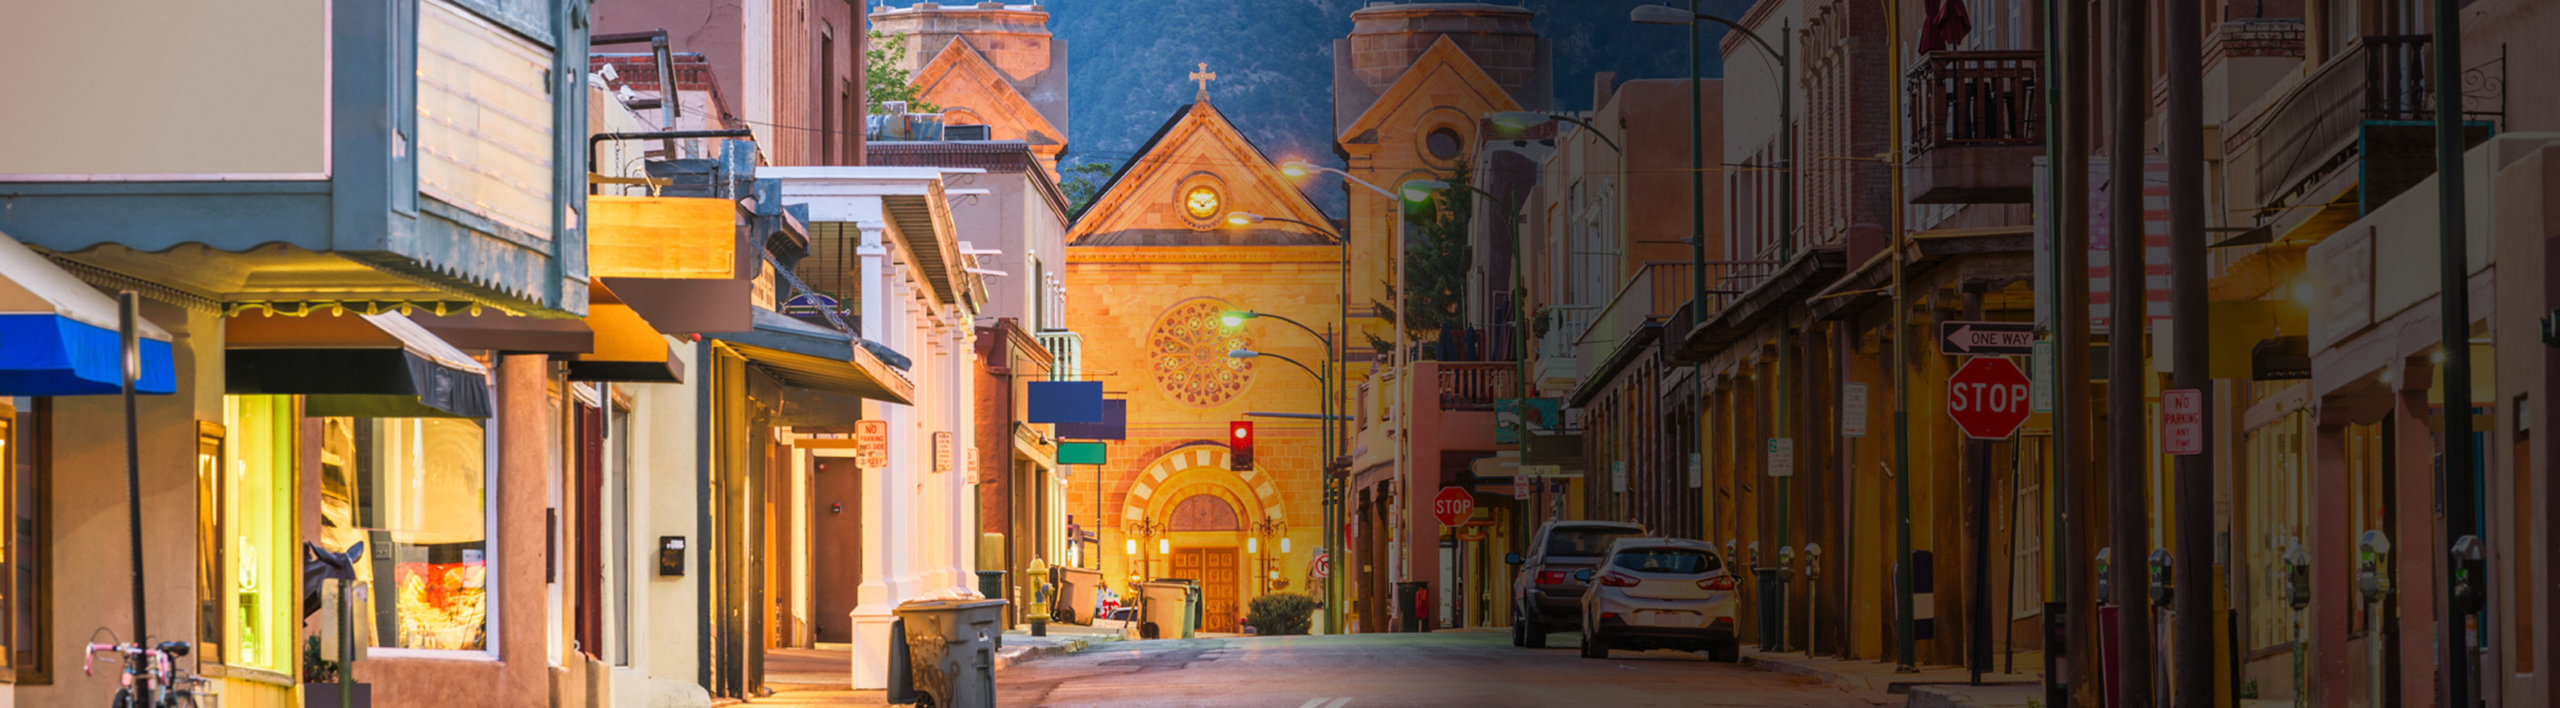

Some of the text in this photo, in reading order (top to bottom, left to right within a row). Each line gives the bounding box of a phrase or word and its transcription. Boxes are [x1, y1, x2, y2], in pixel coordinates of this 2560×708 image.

[1971, 332, 2030, 345] ONE WAY
[1951, 382, 2028, 413] STOP
[2175, 397, 2190, 409] NO
[2165, 412, 2199, 425] PARKING
[865, 424, 877, 434] NO
[2176, 428, 2190, 436] ANY
[2175, 439, 2191, 448] TIME
[1436, 499, 1471, 514] STOP
